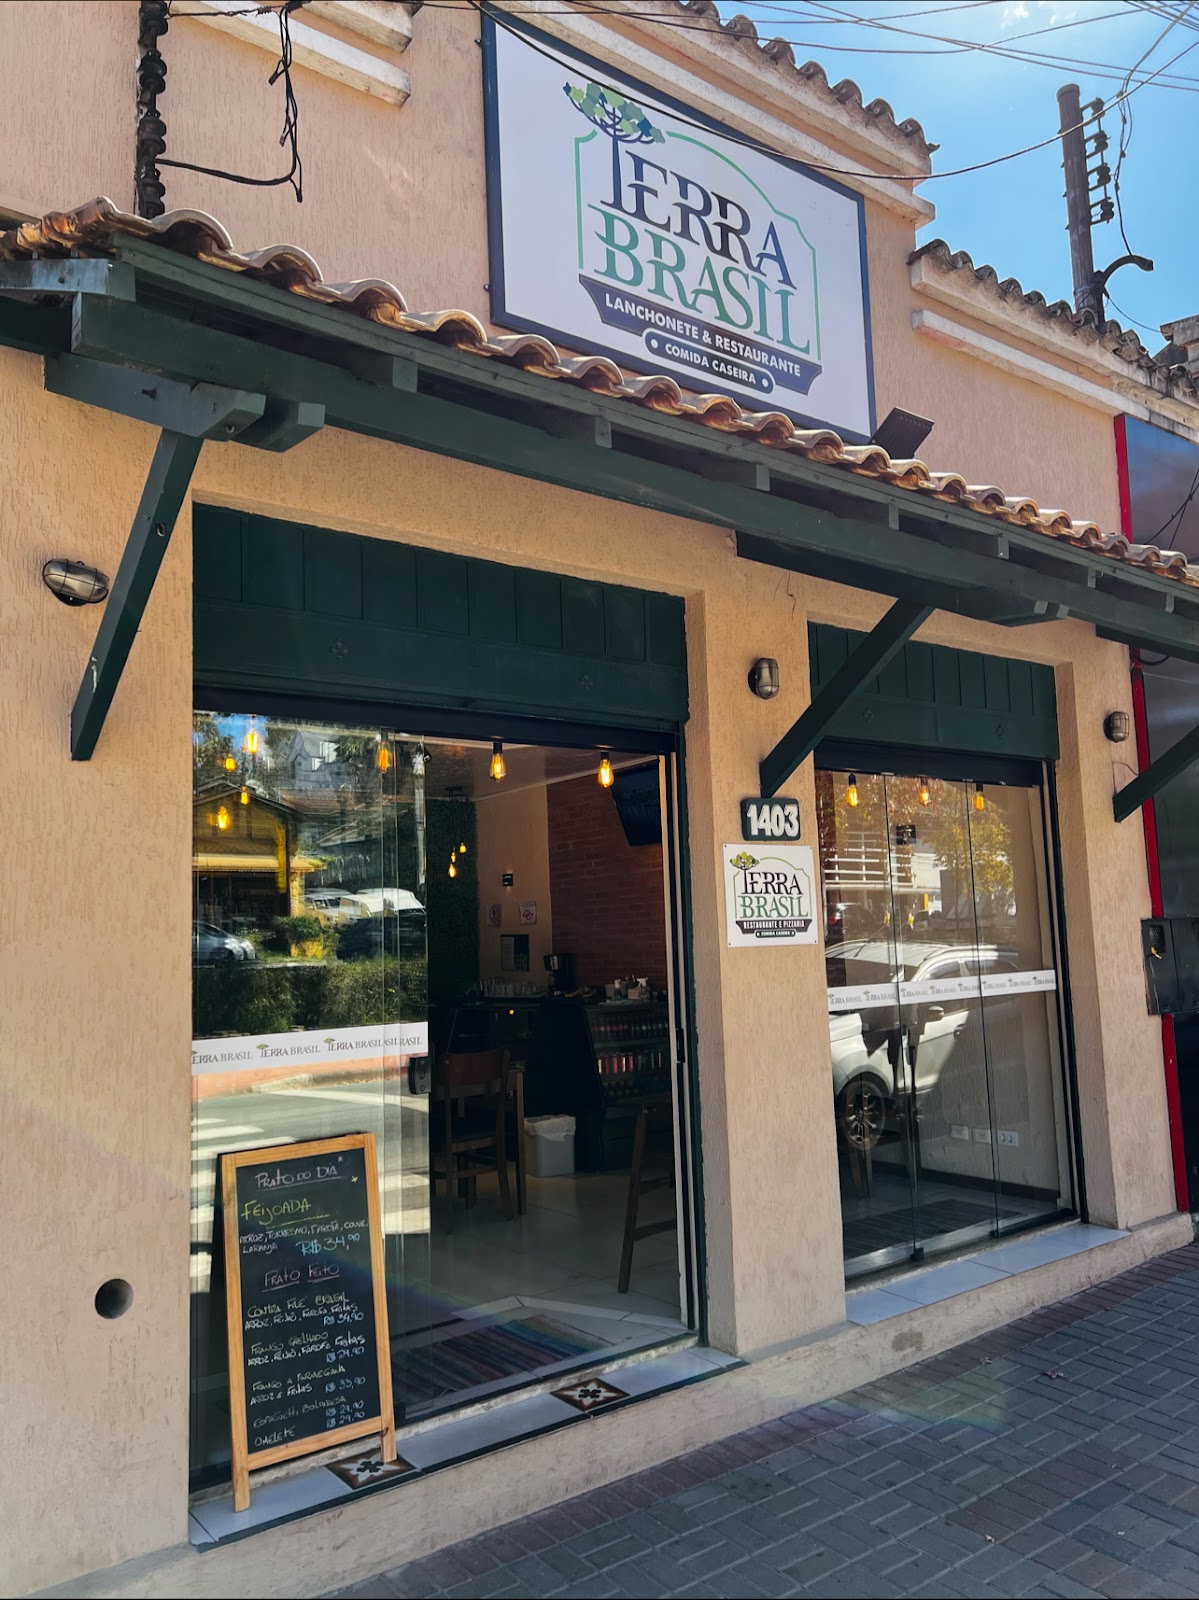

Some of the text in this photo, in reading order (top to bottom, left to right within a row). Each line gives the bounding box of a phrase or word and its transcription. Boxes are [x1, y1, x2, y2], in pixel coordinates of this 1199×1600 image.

[600, 138, 797, 290] TERRA
[587, 203, 810, 355] BRASIL
[605, 293, 801, 377] LANCHONETE & RESTAURANTE
[665, 342, 757, 385] COMIDA CASEIRA
[746, 803, 800, 837] 1403
[740, 869, 804, 895] TERRA
[737, 895, 809, 919] BRASIL
[743, 921, 777, 929] RESTAURANTE
[192, 1053, 219, 1065] ERRA
[219, 1051, 253, 1062] BRASIL
[260, 1048, 289, 1059] TERRA
[290, 1044, 320, 1056] BRASIL
[328, 1041, 354, 1052] TERRA
[355, 1038, 384, 1050] BRASIL
